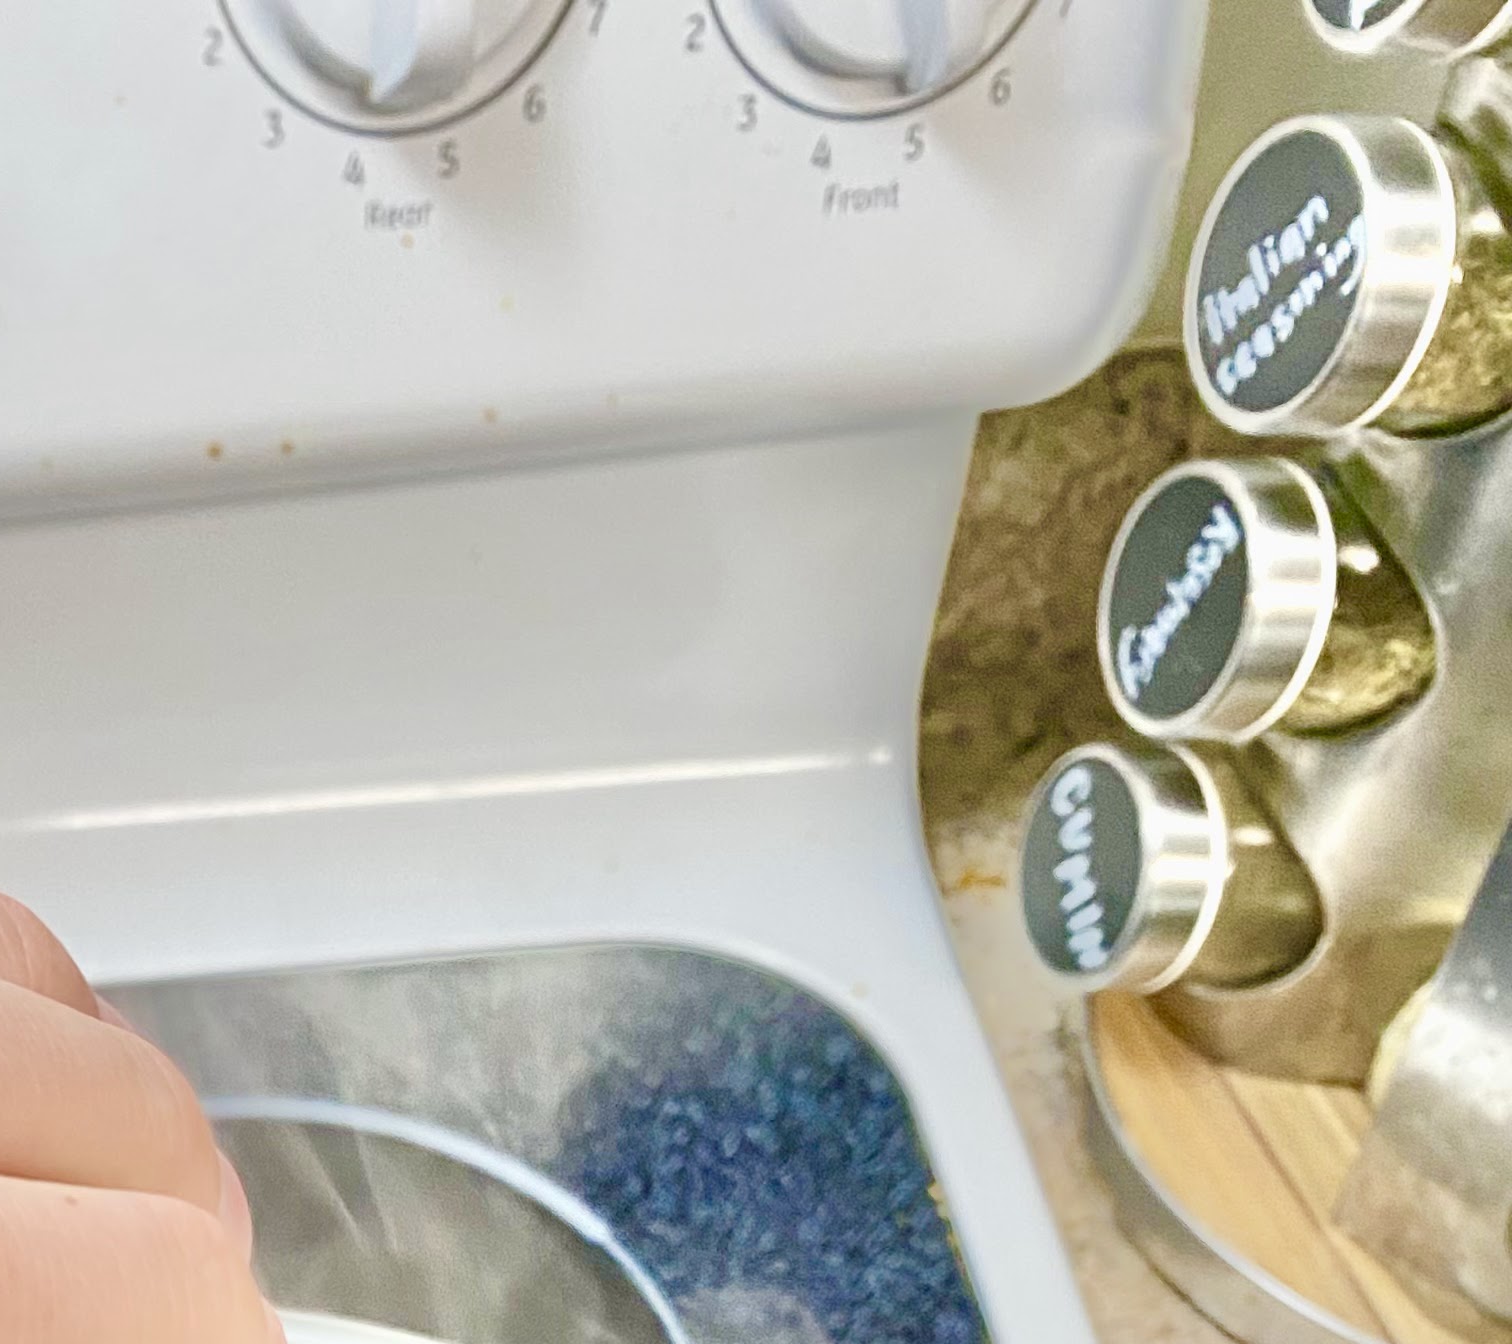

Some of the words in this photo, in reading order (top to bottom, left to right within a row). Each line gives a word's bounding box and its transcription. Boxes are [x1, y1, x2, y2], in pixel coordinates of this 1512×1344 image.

[203, 25, 222, 67] 2
[687, 13, 705, 51] 2
[523, 84, 545, 123] 6
[991, 68, 1012, 106] 6
[262, 108, 284, 148] 3
[738, 94, 757, 132] 3
[439, 139, 460, 179] 5
[809, 133, 832, 169] 4
[904, 122, 925, 161] 5
[342, 150, 366, 188] 4
[822, 178, 900, 215] Front
[1203, 195, 1329, 345] Italian
[1050, 766, 1108, 969] CUMIN
